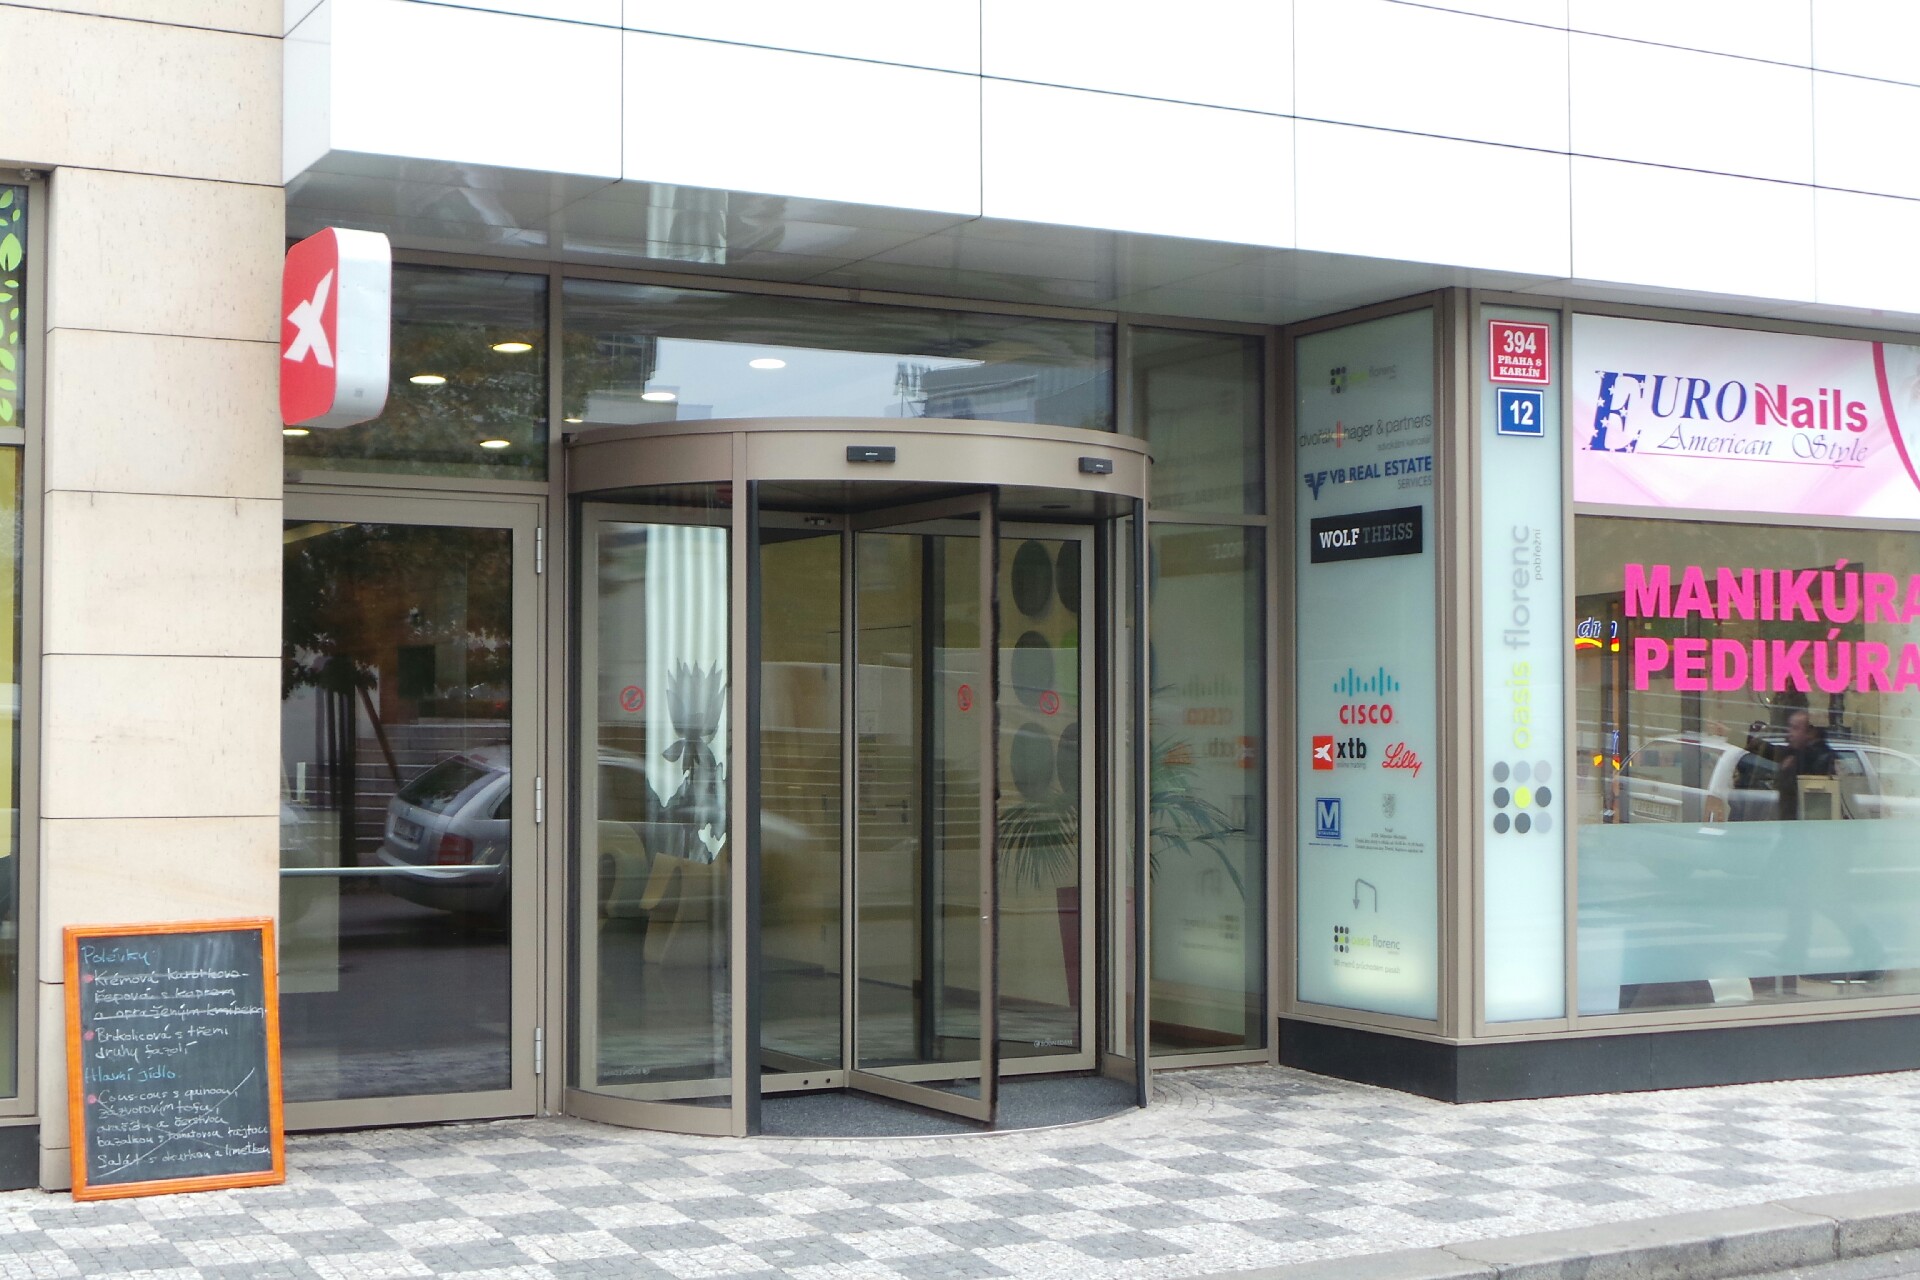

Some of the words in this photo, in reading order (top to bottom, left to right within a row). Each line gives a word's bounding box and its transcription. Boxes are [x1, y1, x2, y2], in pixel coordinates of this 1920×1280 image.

[1503, 330, 1537, 354] 394
[1498, 355, 1533, 366] PRAHA
[1500, 366, 1540, 377] KARLÍN
[1510, 400, 1534, 425] 12
[1582, 370, 1748, 454] EURO
[1755, 382, 1869, 433] Nails
[1343, 424, 1374, 442] hager
[1376, 419, 1384, 435] &
[1385, 414, 1432, 437] partners
[1657, 423, 1772, 456] American
[1791, 433, 1868, 469] Style
[1330, 468, 1346, 484] VB
[1349, 463, 1381, 481] REAL
[1384, 455, 1432, 476] ESTATE
[1397, 475, 1432, 490] SERVICES
[1319, 527, 1360, 549] WOLF
[1362, 522, 1413, 544] THEISS
[1504, 525, 1531, 650] florenc
[1340, 704, 1393, 724] CISCO
[1508, 661, 1533, 750] oasis
[1337, 738, 1367, 758] xtb
[1382, 742, 1422, 778] Lilly
[1373, 934, 1401, 950] florenc
[175, 1031, 183, 1039] s
[95, 1044, 140, 1063] druhy
[84, 1066, 133, 1083] Hlavní
[173, 1090, 180, 1098] s
[97, 1153, 140, 1168] Salát
